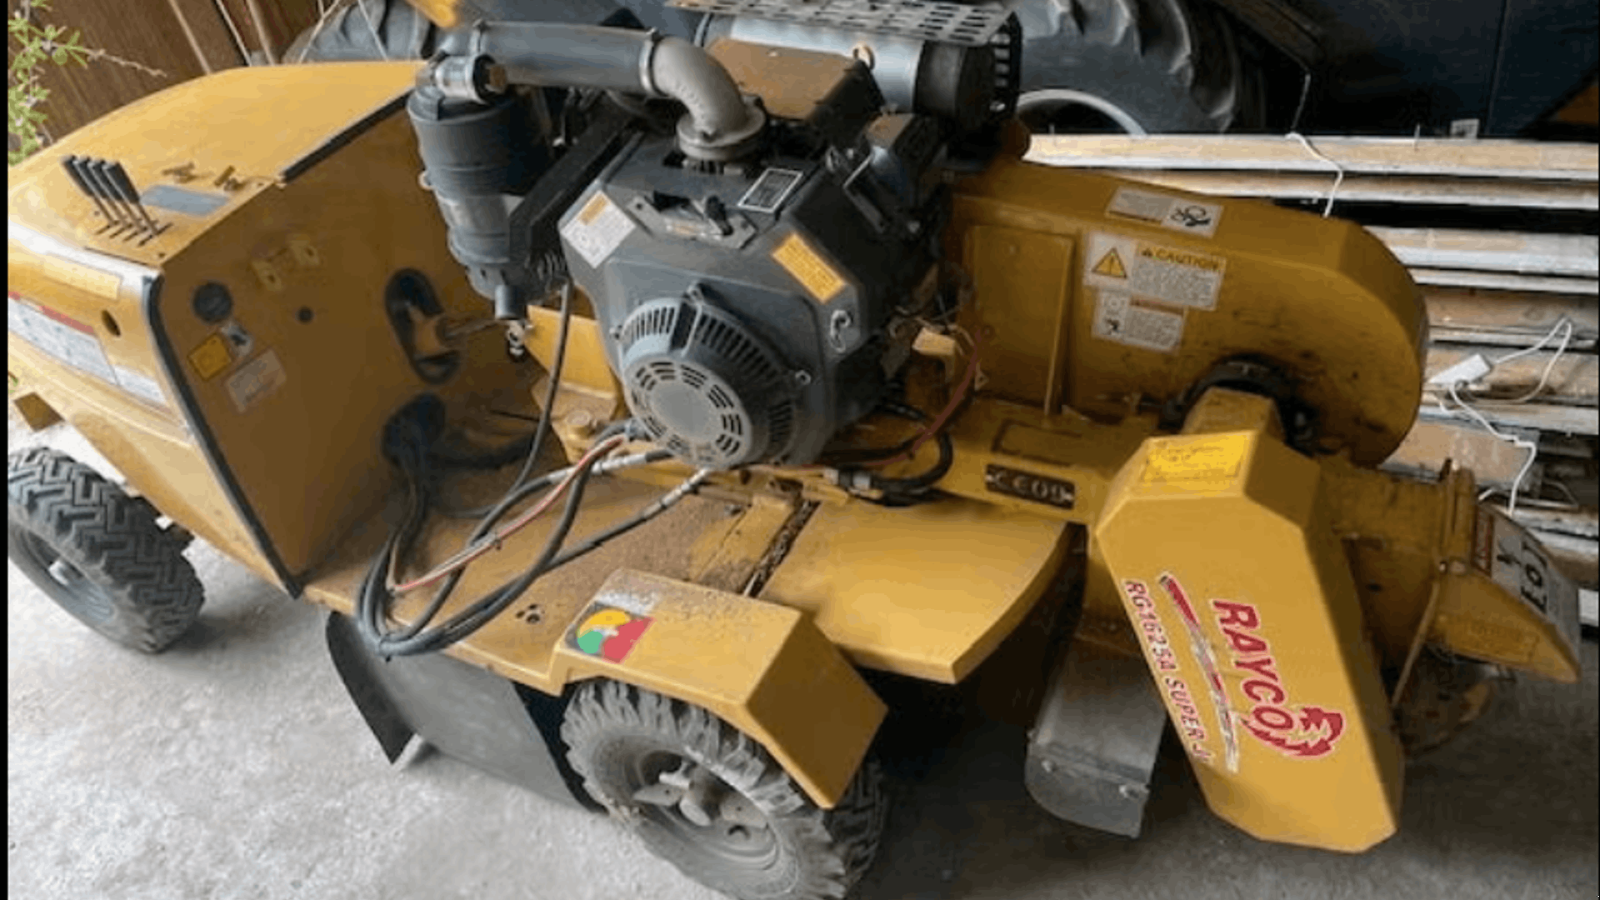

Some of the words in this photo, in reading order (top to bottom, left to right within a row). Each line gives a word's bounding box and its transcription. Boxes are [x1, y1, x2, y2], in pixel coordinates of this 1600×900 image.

[1155, 246, 1220, 271] CAUTION
[1123, 579, 1177, 671] RG1625A
[1165, 677, 1206, 742] SUPER
[1209, 598, 1295, 733] RAYCO
